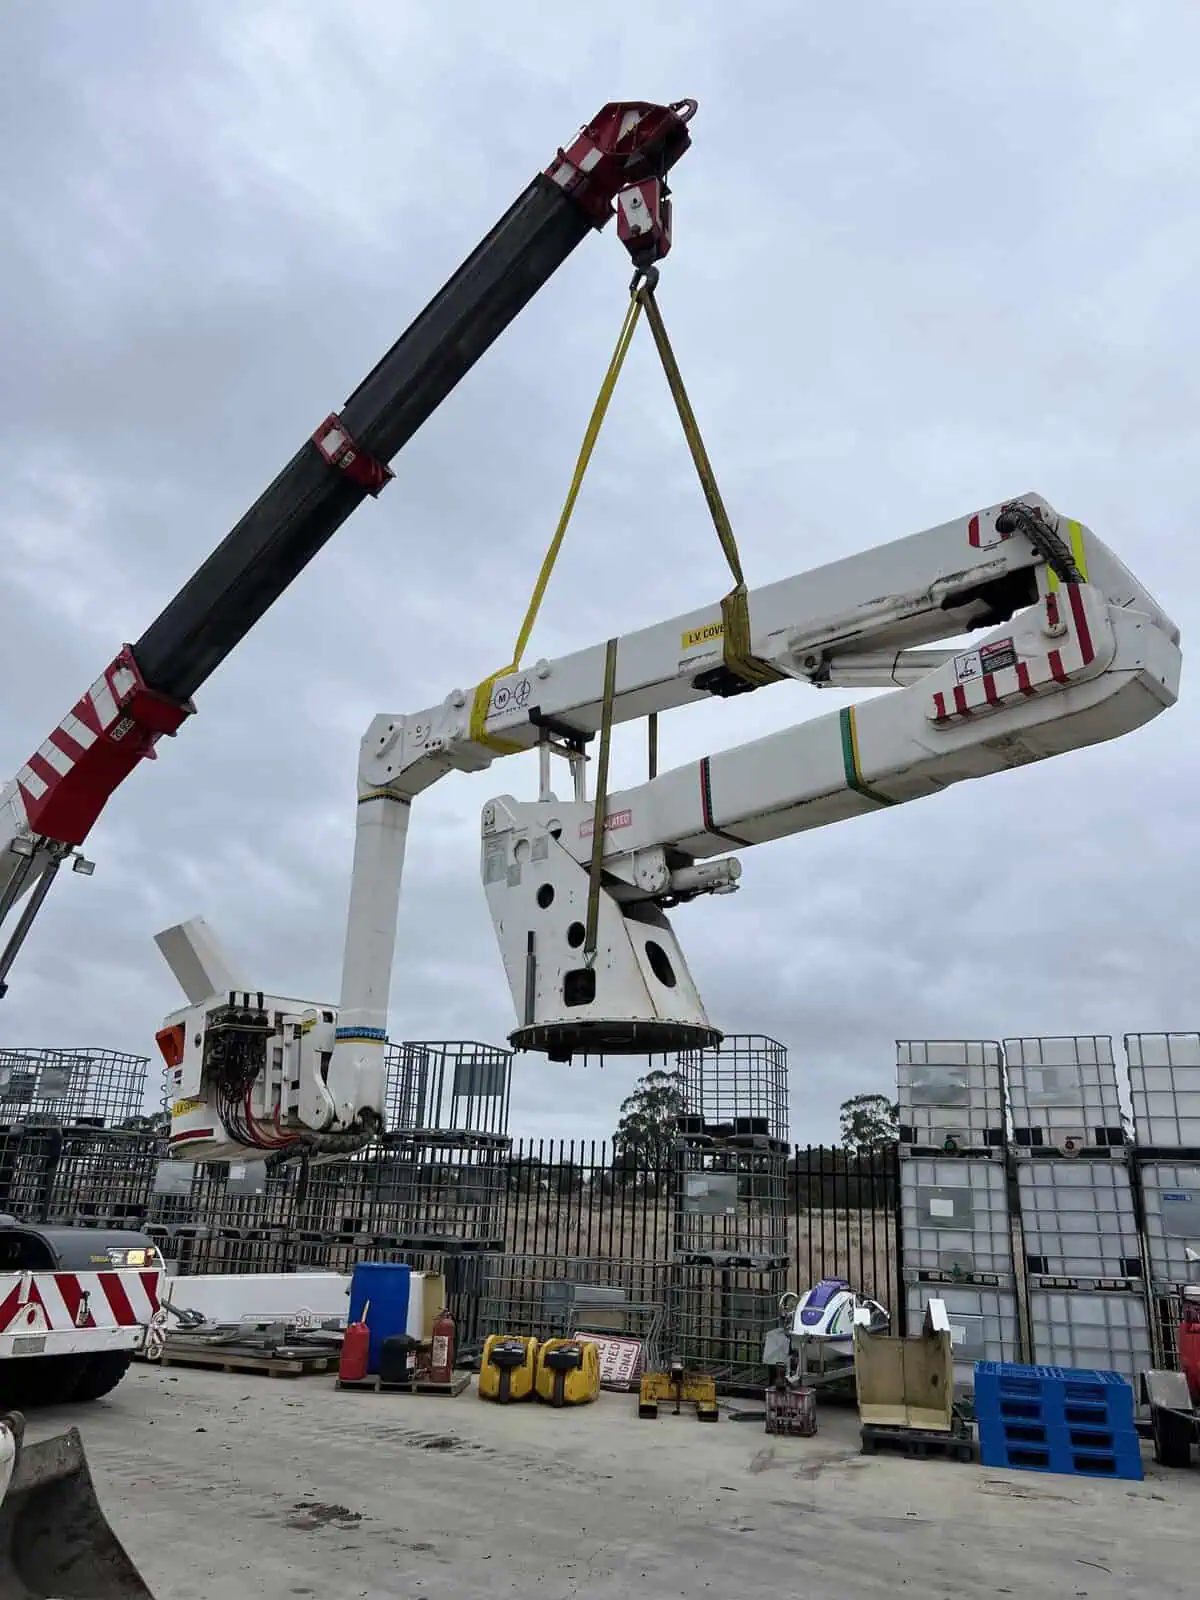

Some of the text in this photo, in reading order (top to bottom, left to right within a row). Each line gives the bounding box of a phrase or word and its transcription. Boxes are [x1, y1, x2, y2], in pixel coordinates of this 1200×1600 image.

[703, 624, 726, 638] COVE
[606, 1343, 620, 1364] RED
[615, 1345, 634, 1383] SIGNAL
